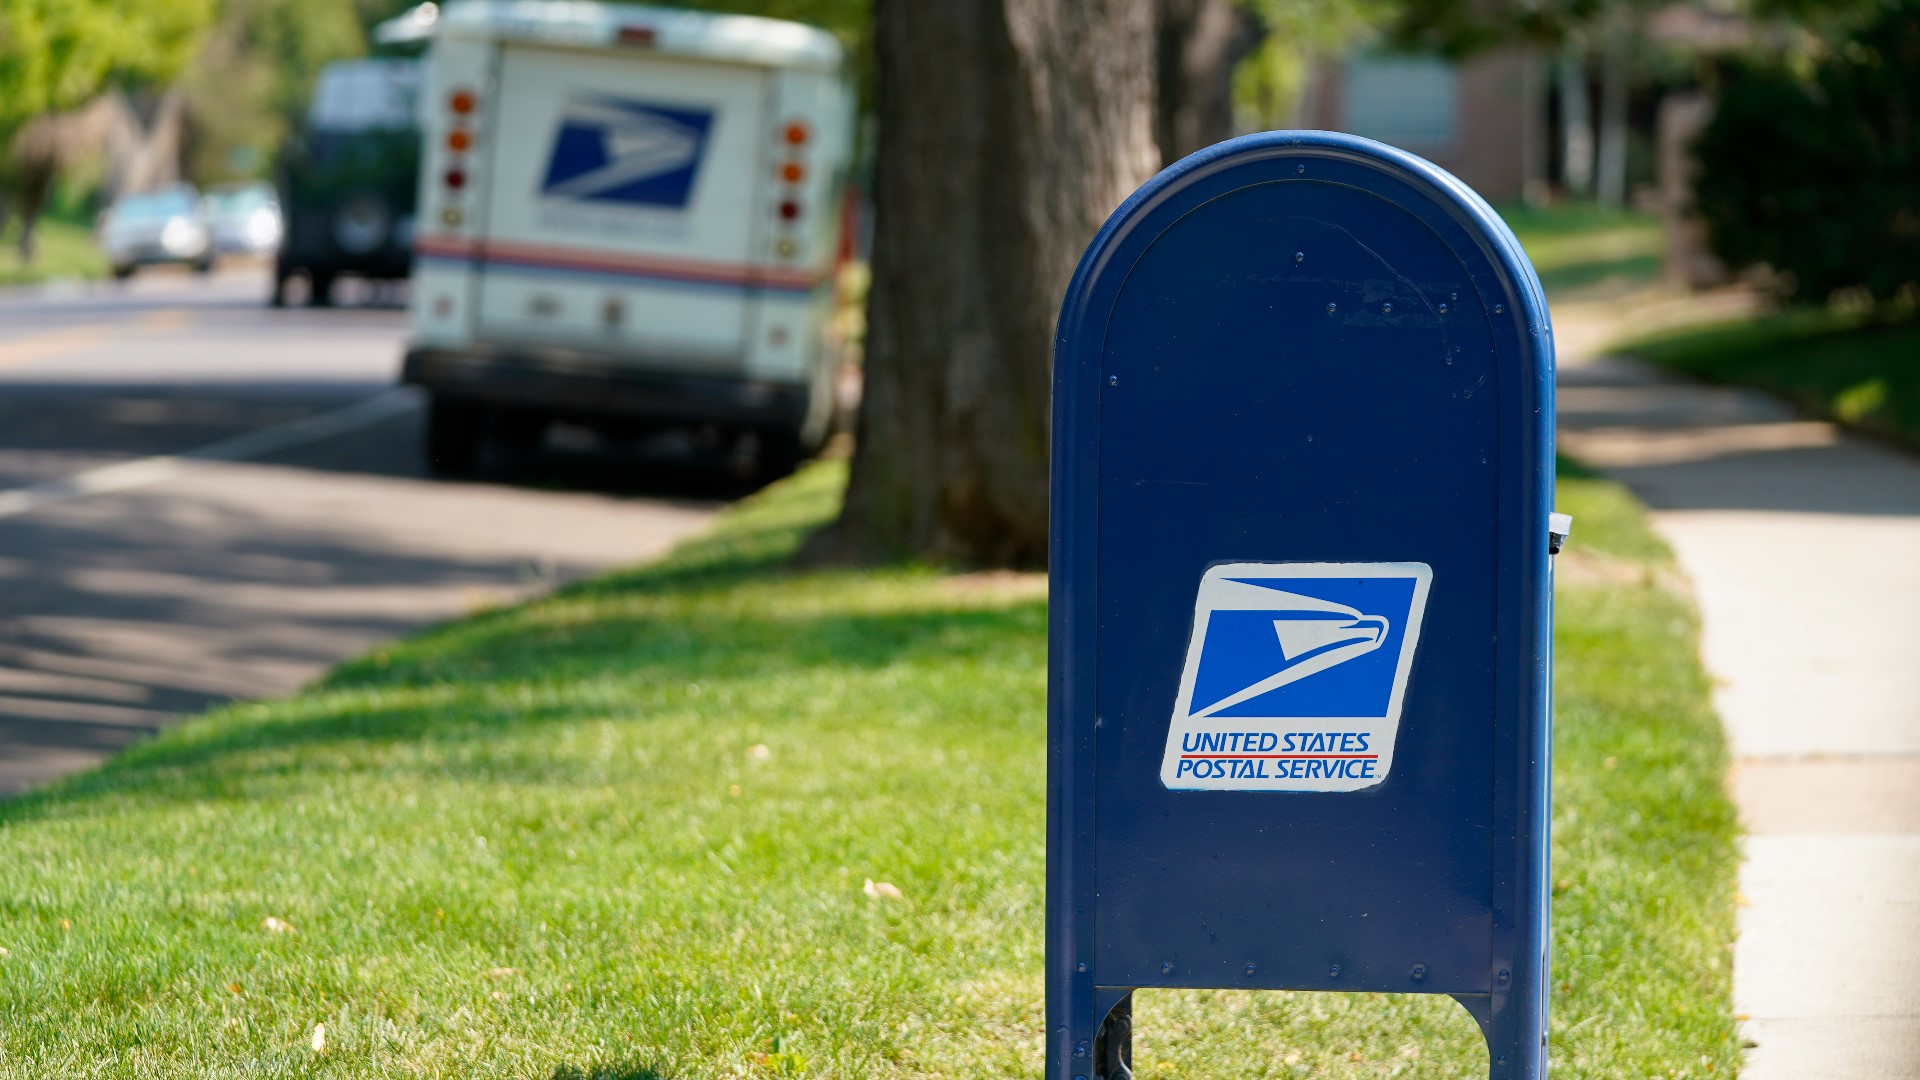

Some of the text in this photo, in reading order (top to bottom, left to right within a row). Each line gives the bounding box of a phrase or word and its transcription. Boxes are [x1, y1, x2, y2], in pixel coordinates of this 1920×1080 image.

[1182, 732, 1370, 752] UNITED STATES
[1176, 759, 1378, 779] POSTAL SERVICE
